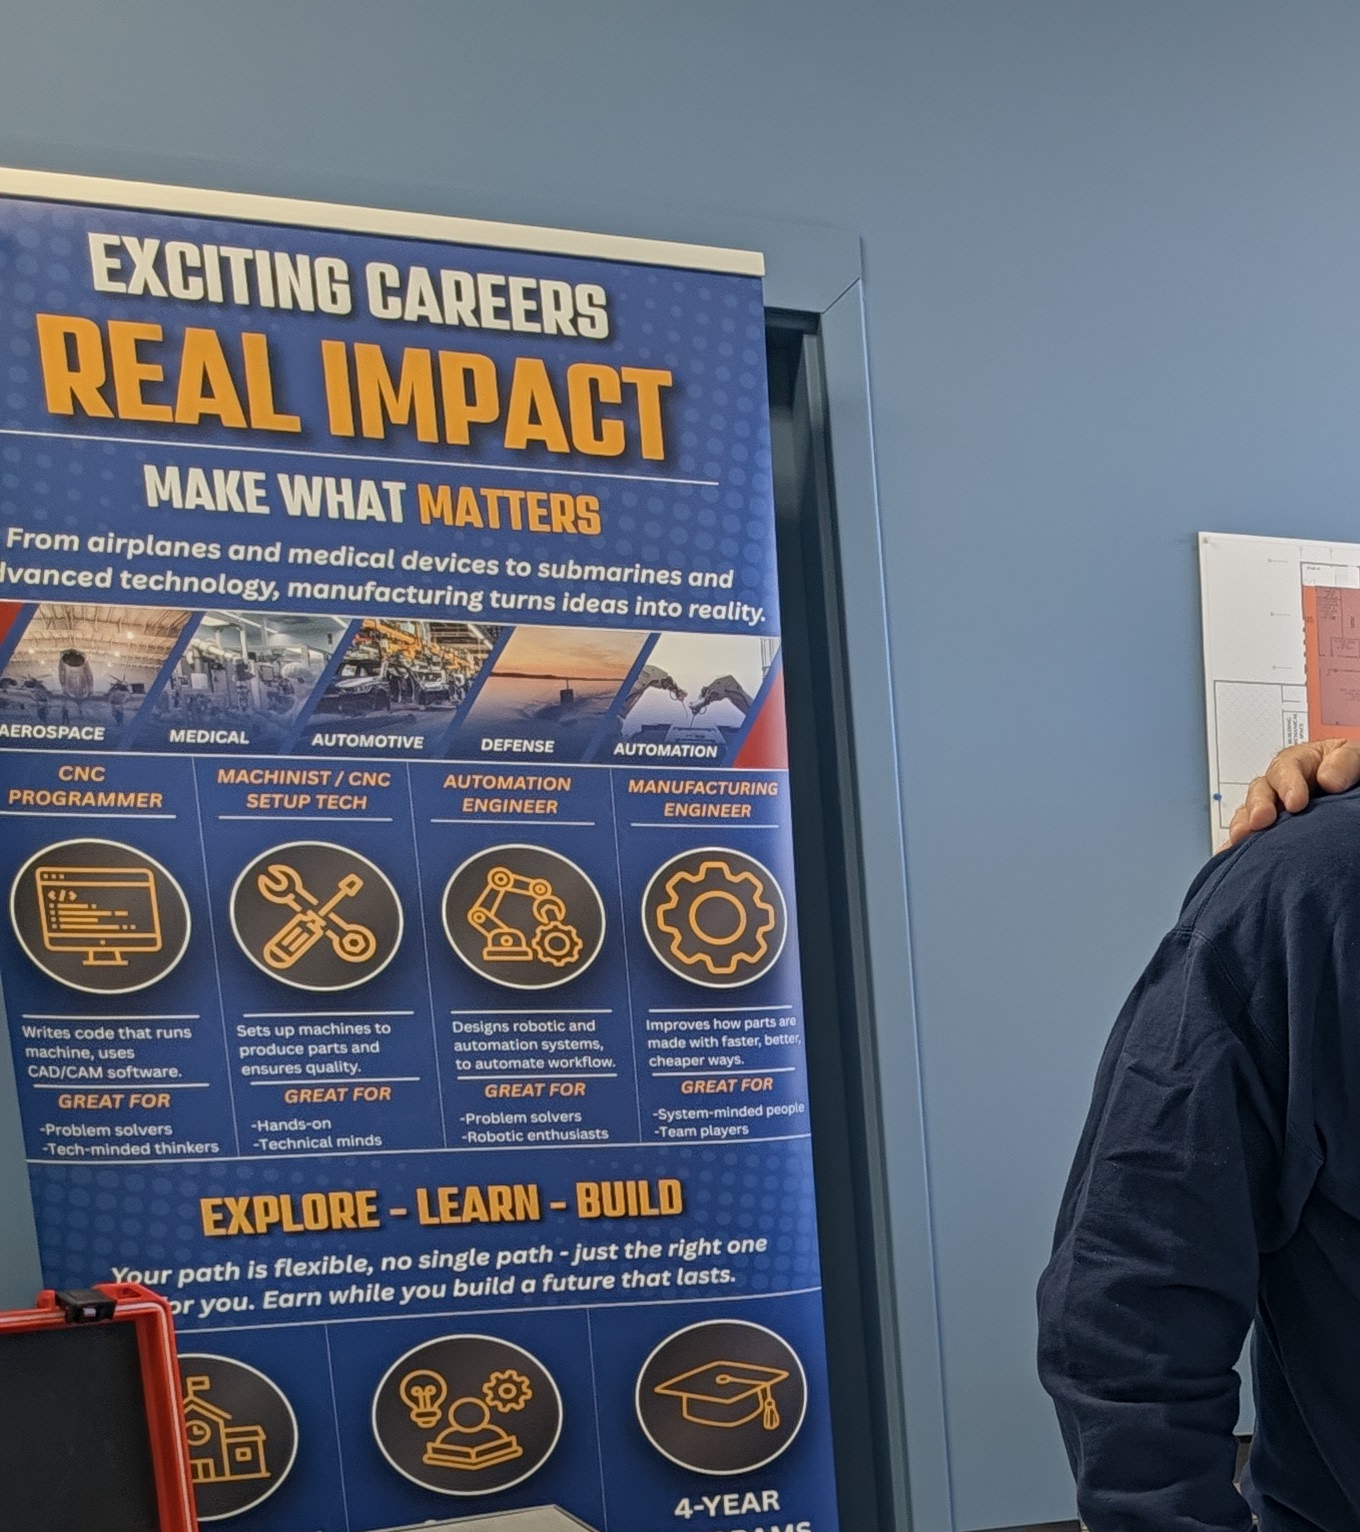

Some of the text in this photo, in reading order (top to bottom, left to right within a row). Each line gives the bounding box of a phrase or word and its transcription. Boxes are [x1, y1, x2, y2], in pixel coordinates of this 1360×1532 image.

[87, 231, 609, 339] EXCITING CAREERS
[35, 312, 673, 461] REAL IMPACT
[142, 463, 602, 536] MAKE WHAT MATTERS
[7, 527, 734, 589] From airplanes and medical devices to submarines and
[120, 570, 279, 601] technology,
[287, 581, 483, 612] manufacturing
[490, 589, 555, 612] turns
[562, 592, 629, 615] ideas
[635, 597, 682, 617] into
[688, 603, 766, 626] reality.
[0, 724, 105, 740] AEROSPACE
[170, 729, 249, 744] MEDICAL
[311, 732, 424, 750] AUTOMOTIVE
[481, 738, 555, 753] DEFENSE
[614, 742, 718, 758] AUTOMATION
[58, 766, 106, 782] CNC
[217, 769, 391, 787] MACHINIST CNC
[443, 774, 571, 792] AUTOMATION
[628, 779, 778, 796] MANUFACTURING
[9, 790, 163, 809] PROGRAMMER
[246, 793, 367, 810] SETUP TECH
[462, 797, 558, 815] ENGINEER
[664, 802, 752, 818] ENGINEER
[22, 1025, 192, 1039] Writes code that runs
[237, 1022, 391, 1038] Sets up machines to
[452, 1019, 595, 1035] Designs robotic and
[646, 1016, 796, 1033] Improves how parts are
[454, 1039, 604, 1053] automation systems,
[648, 1033, 801, 1048] made with faster, better,
[25, 1046, 135, 1061] machine, uses
[239, 1041, 380, 1059] produce parts and
[241, 1060, 362, 1076] ensures quality.
[456, 1055, 616, 1070] to automate workflow.
[649, 1055, 744, 1068] cheaper ways.
[28, 1065, 183, 1079] CAD/CAM software.
[485, 1082, 586, 1098] GREAT FOR
[681, 1077, 774, 1094] GREAT FOR
[58, 1093, 170, 1109] GREAT FOR
[285, 1086, 391, 1104] GREAT FOR
[530, 1110, 582, 1123] solvers
[766, 1102, 805, 1118] people
[115, 1124, 173, 1136] solvers
[527, 1128, 609, 1141] enthusiasts
[701, 1124, 749, 1139] players
[155, 1141, 219, 1154] thinkers
[337, 1134, 382, 1147] minds
[199, 1179, 683, 1237] EXPLORE LEARN BUILD
[112, 1235, 767, 1287] Your path is flexible, no single path just the right one
[198, 1266, 736, 1318] you. Earn while you build a future that lasts.
[674, 1490, 780, 1519] 4-YEAR
